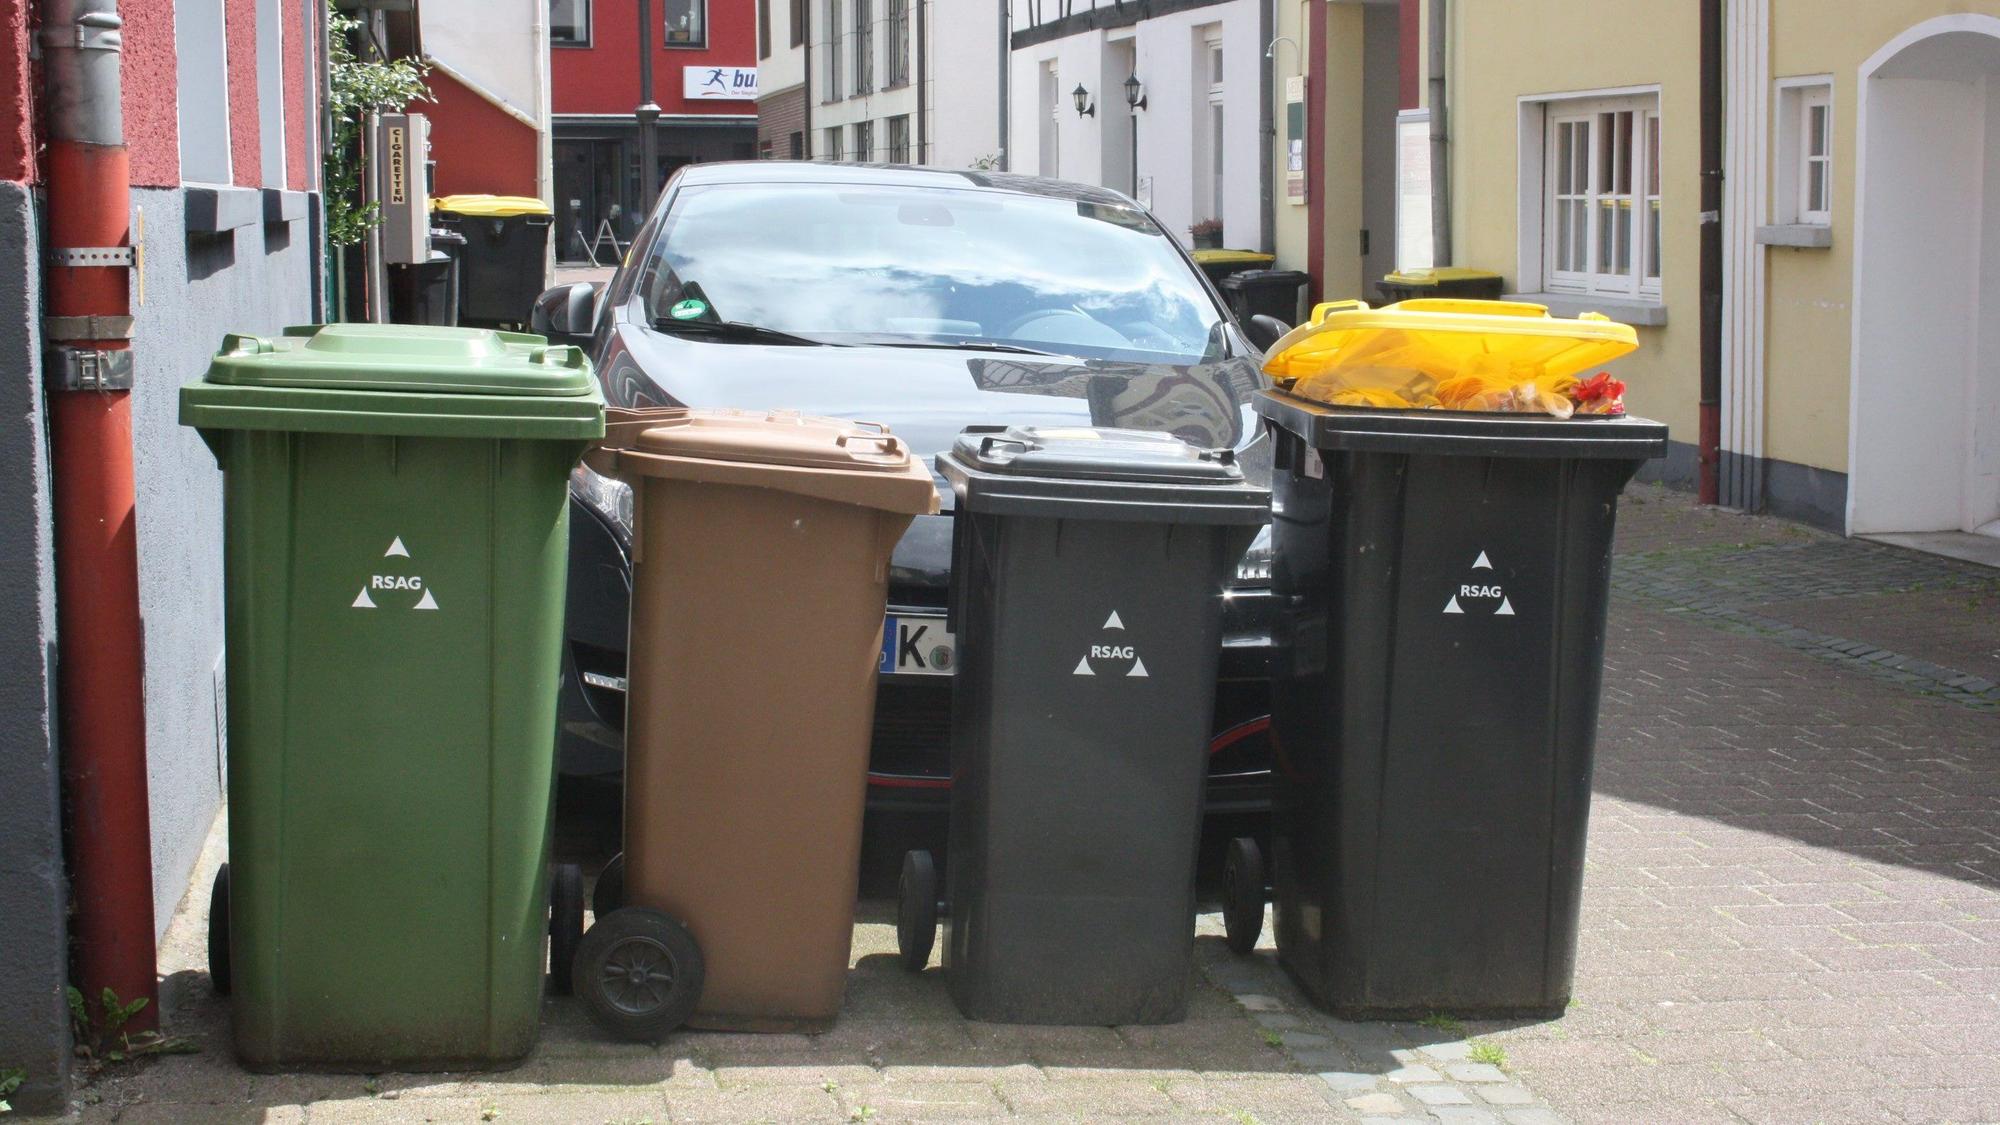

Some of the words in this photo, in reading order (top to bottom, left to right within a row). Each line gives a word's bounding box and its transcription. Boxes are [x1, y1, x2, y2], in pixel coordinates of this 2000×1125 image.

[391, 129, 404, 203] CIGARETTEN
[371, 575, 422, 590] RSAG
[1460, 584, 1502, 598] RSAG
[898, 624, 929, 668] K
[1090, 645, 1135, 659] RSAG
